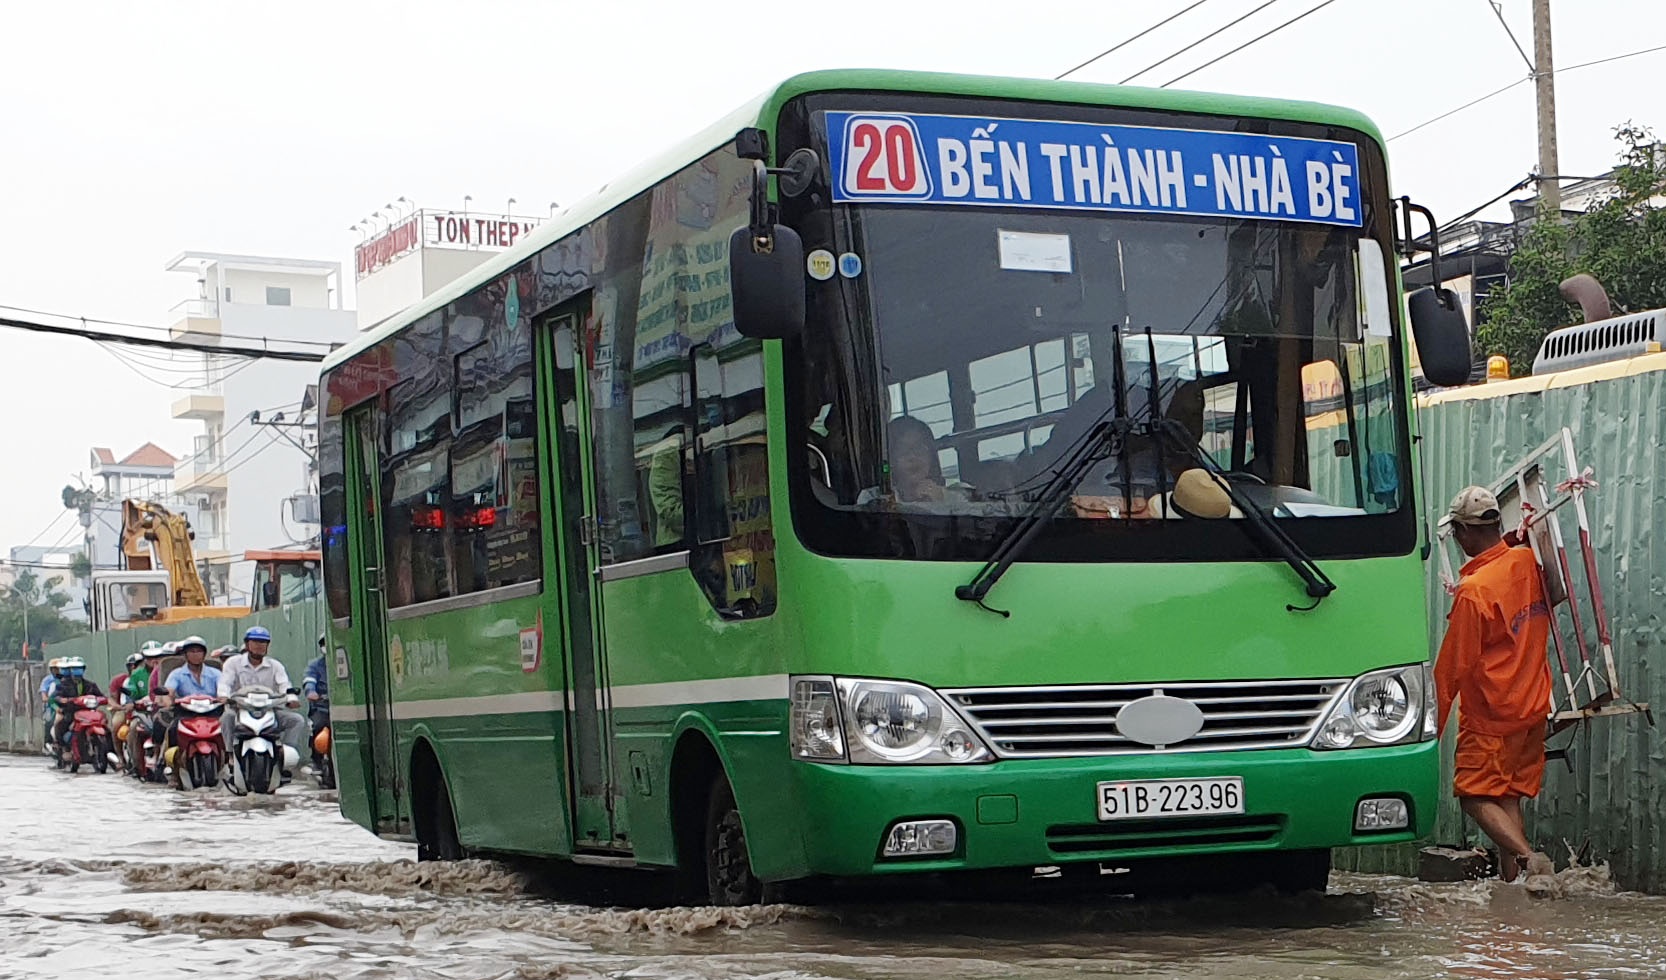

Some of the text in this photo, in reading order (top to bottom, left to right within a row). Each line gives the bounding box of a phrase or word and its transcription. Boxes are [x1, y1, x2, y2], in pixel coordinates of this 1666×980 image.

[855, 124, 917, 192] 20
[938, 122, 1031, 200] BẾN
[1040, 133, 1187, 209] THÀNH
[1212, 144, 1296, 215] NHÀ
[1306, 150, 1355, 221] BÈ
[434, 210, 471, 244] TÔN
[1103, 783, 1238, 815] 51B-223.96
